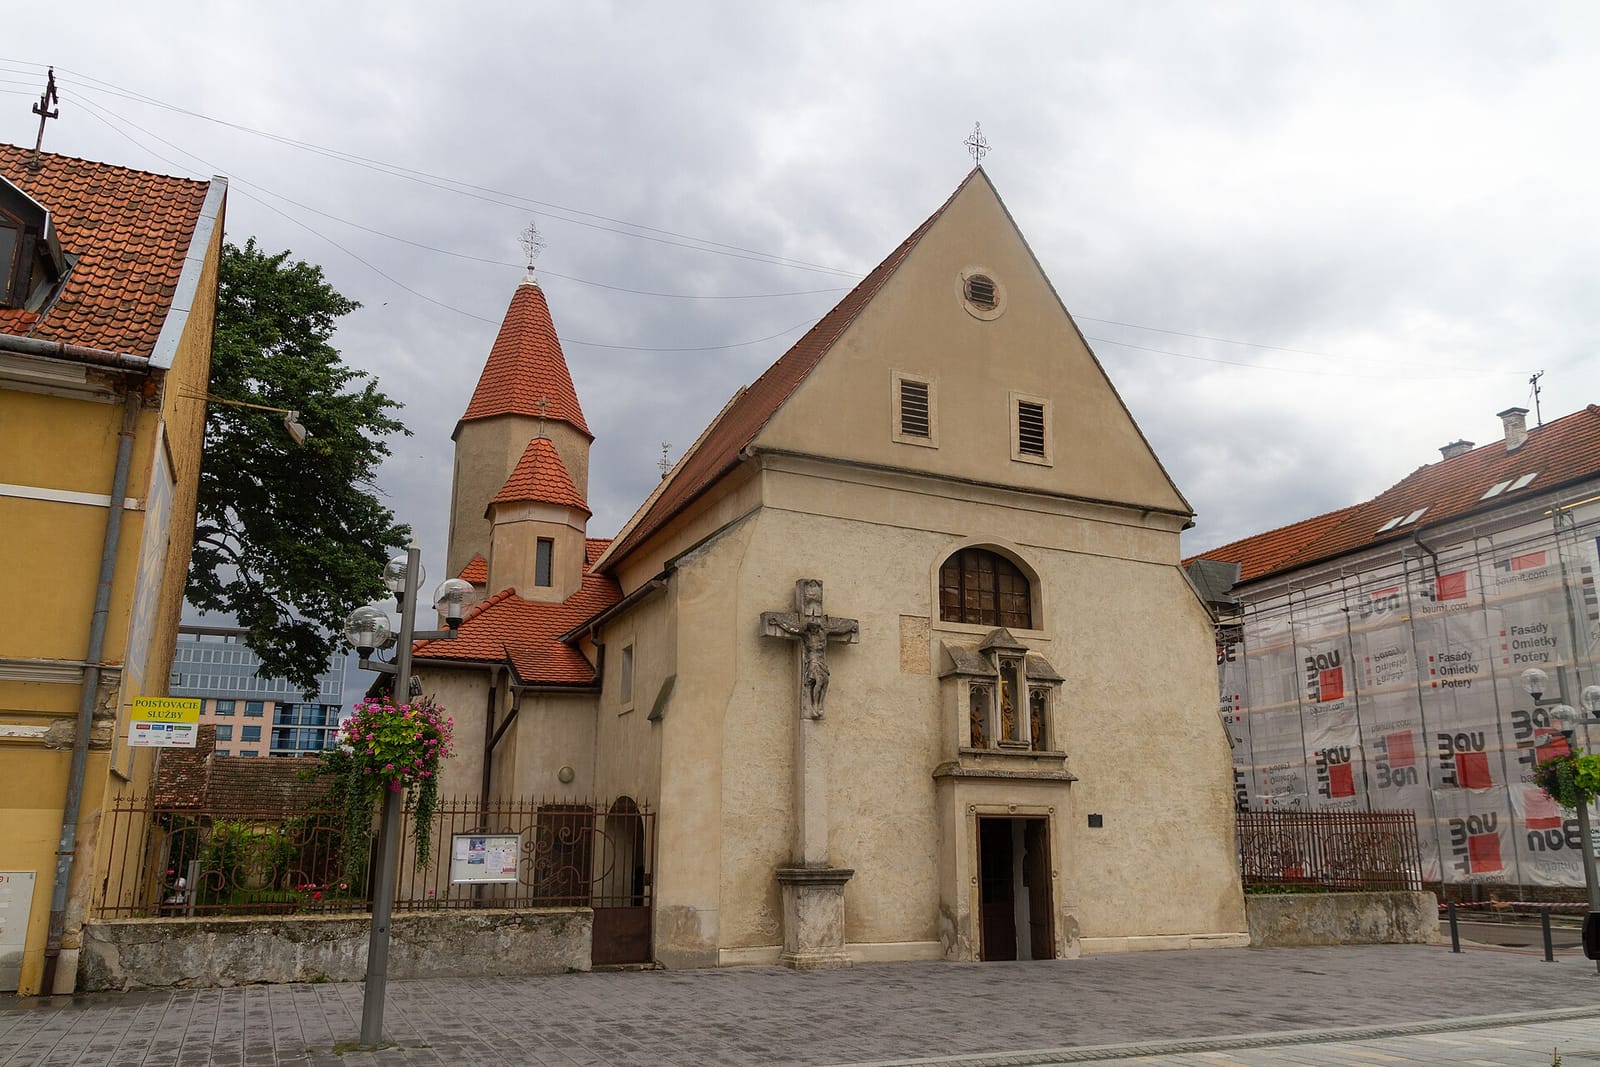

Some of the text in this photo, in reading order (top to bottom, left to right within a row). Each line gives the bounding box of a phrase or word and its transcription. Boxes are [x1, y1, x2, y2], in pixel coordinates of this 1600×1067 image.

[1512, 636, 1557, 650] Omietky
[1438, 651, 1472, 662] Fasády
[1513, 652, 1549, 664] Potery
[1440, 664, 1479, 676] Omietky
[1441, 679, 1472, 688] Potery
[147, 710, 183, 719] SLUŽBY
